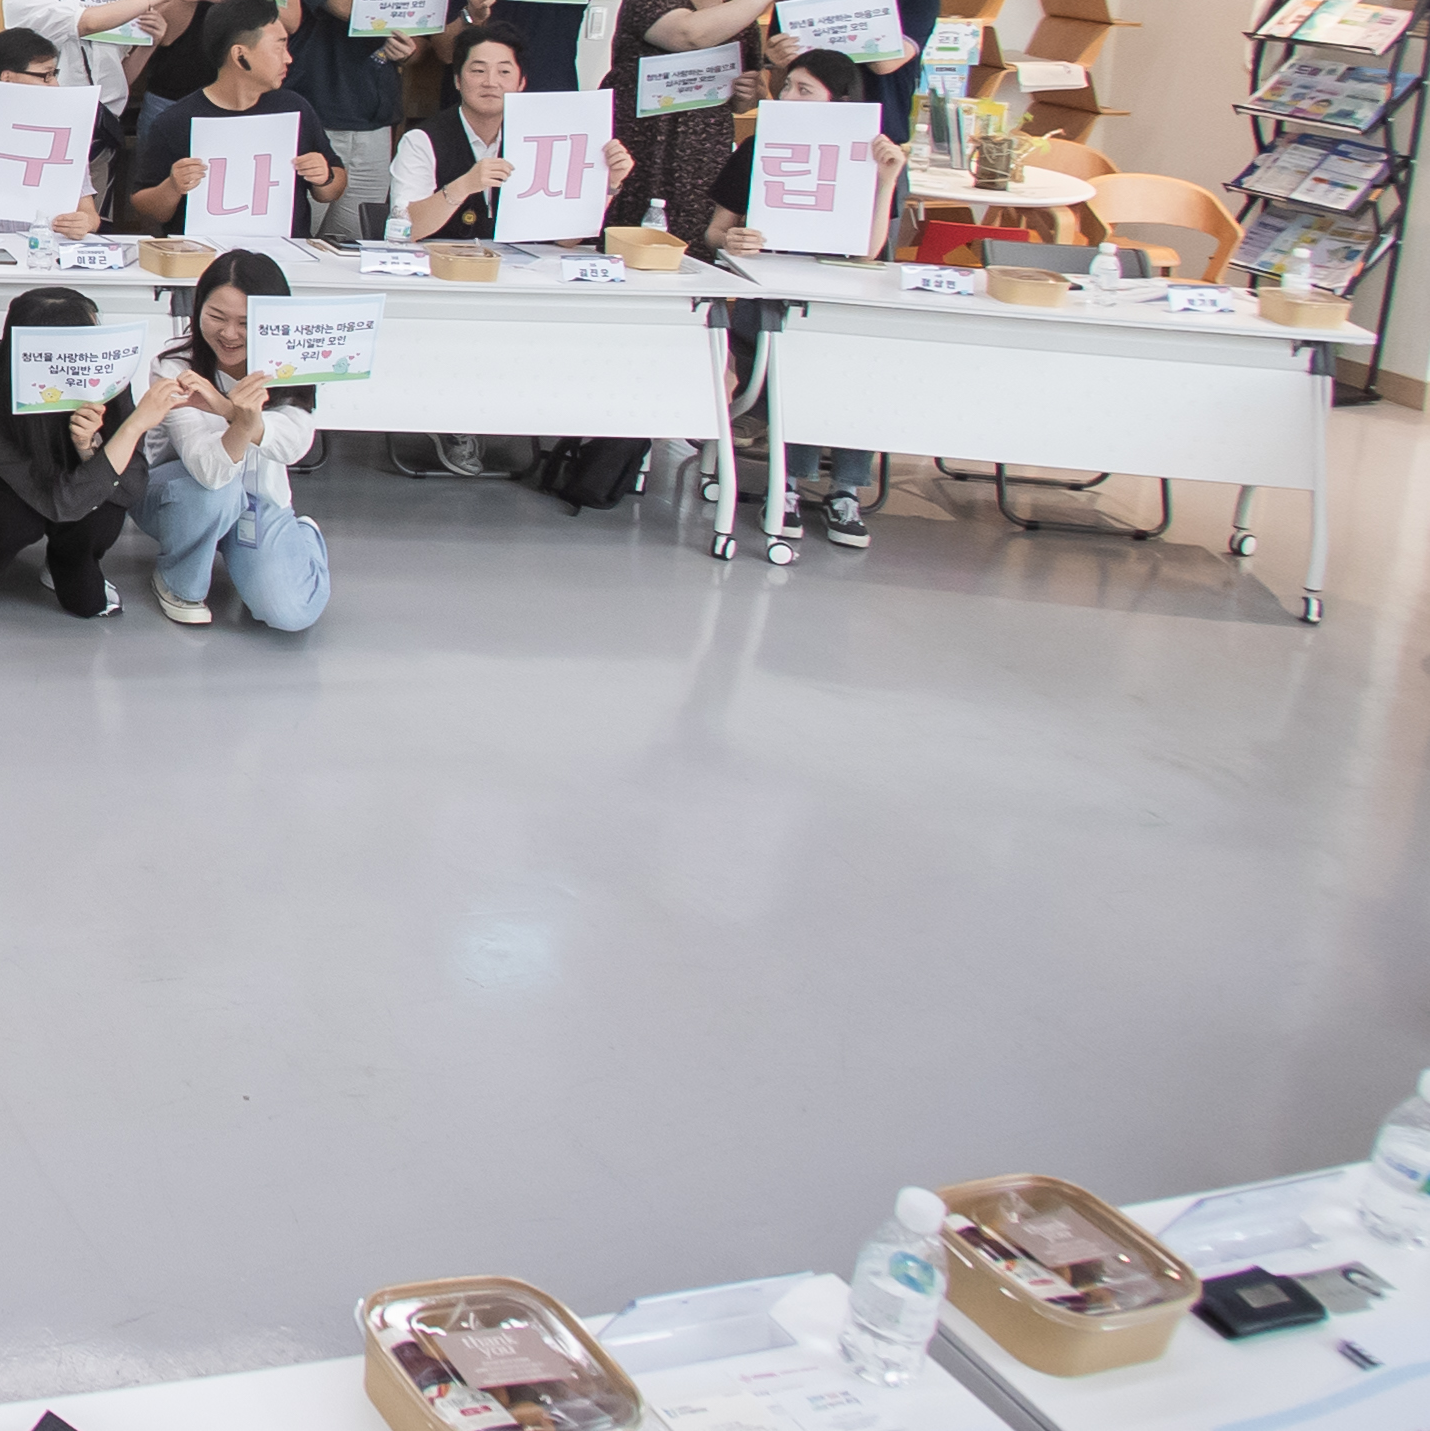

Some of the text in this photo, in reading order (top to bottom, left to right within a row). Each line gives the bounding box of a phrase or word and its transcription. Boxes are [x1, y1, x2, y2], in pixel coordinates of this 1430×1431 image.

[789, 8, 889, 29] 청년을 사랑하는 마음으로
[813, 22, 868, 36] 십시일반 모인
[830, 36, 847, 44] 우리
[517, 134, 595, 199] 자
[206, 153, 279, 216] 나
[259, 321, 374, 335] 청년을 사랑하는 마음으로
[286, 336, 346, 349] 십시일반 모인
[23, 346, 138, 363] 청년을 사랑하는 마음으로
[301, 351, 320, 360] 우리
[50, 363, 113, 375] 십시일반 모인
[66, 378, 86, 388] 우리
[461, 1332, 518, 1350] thank
[479, 1343, 517, 1360] you
